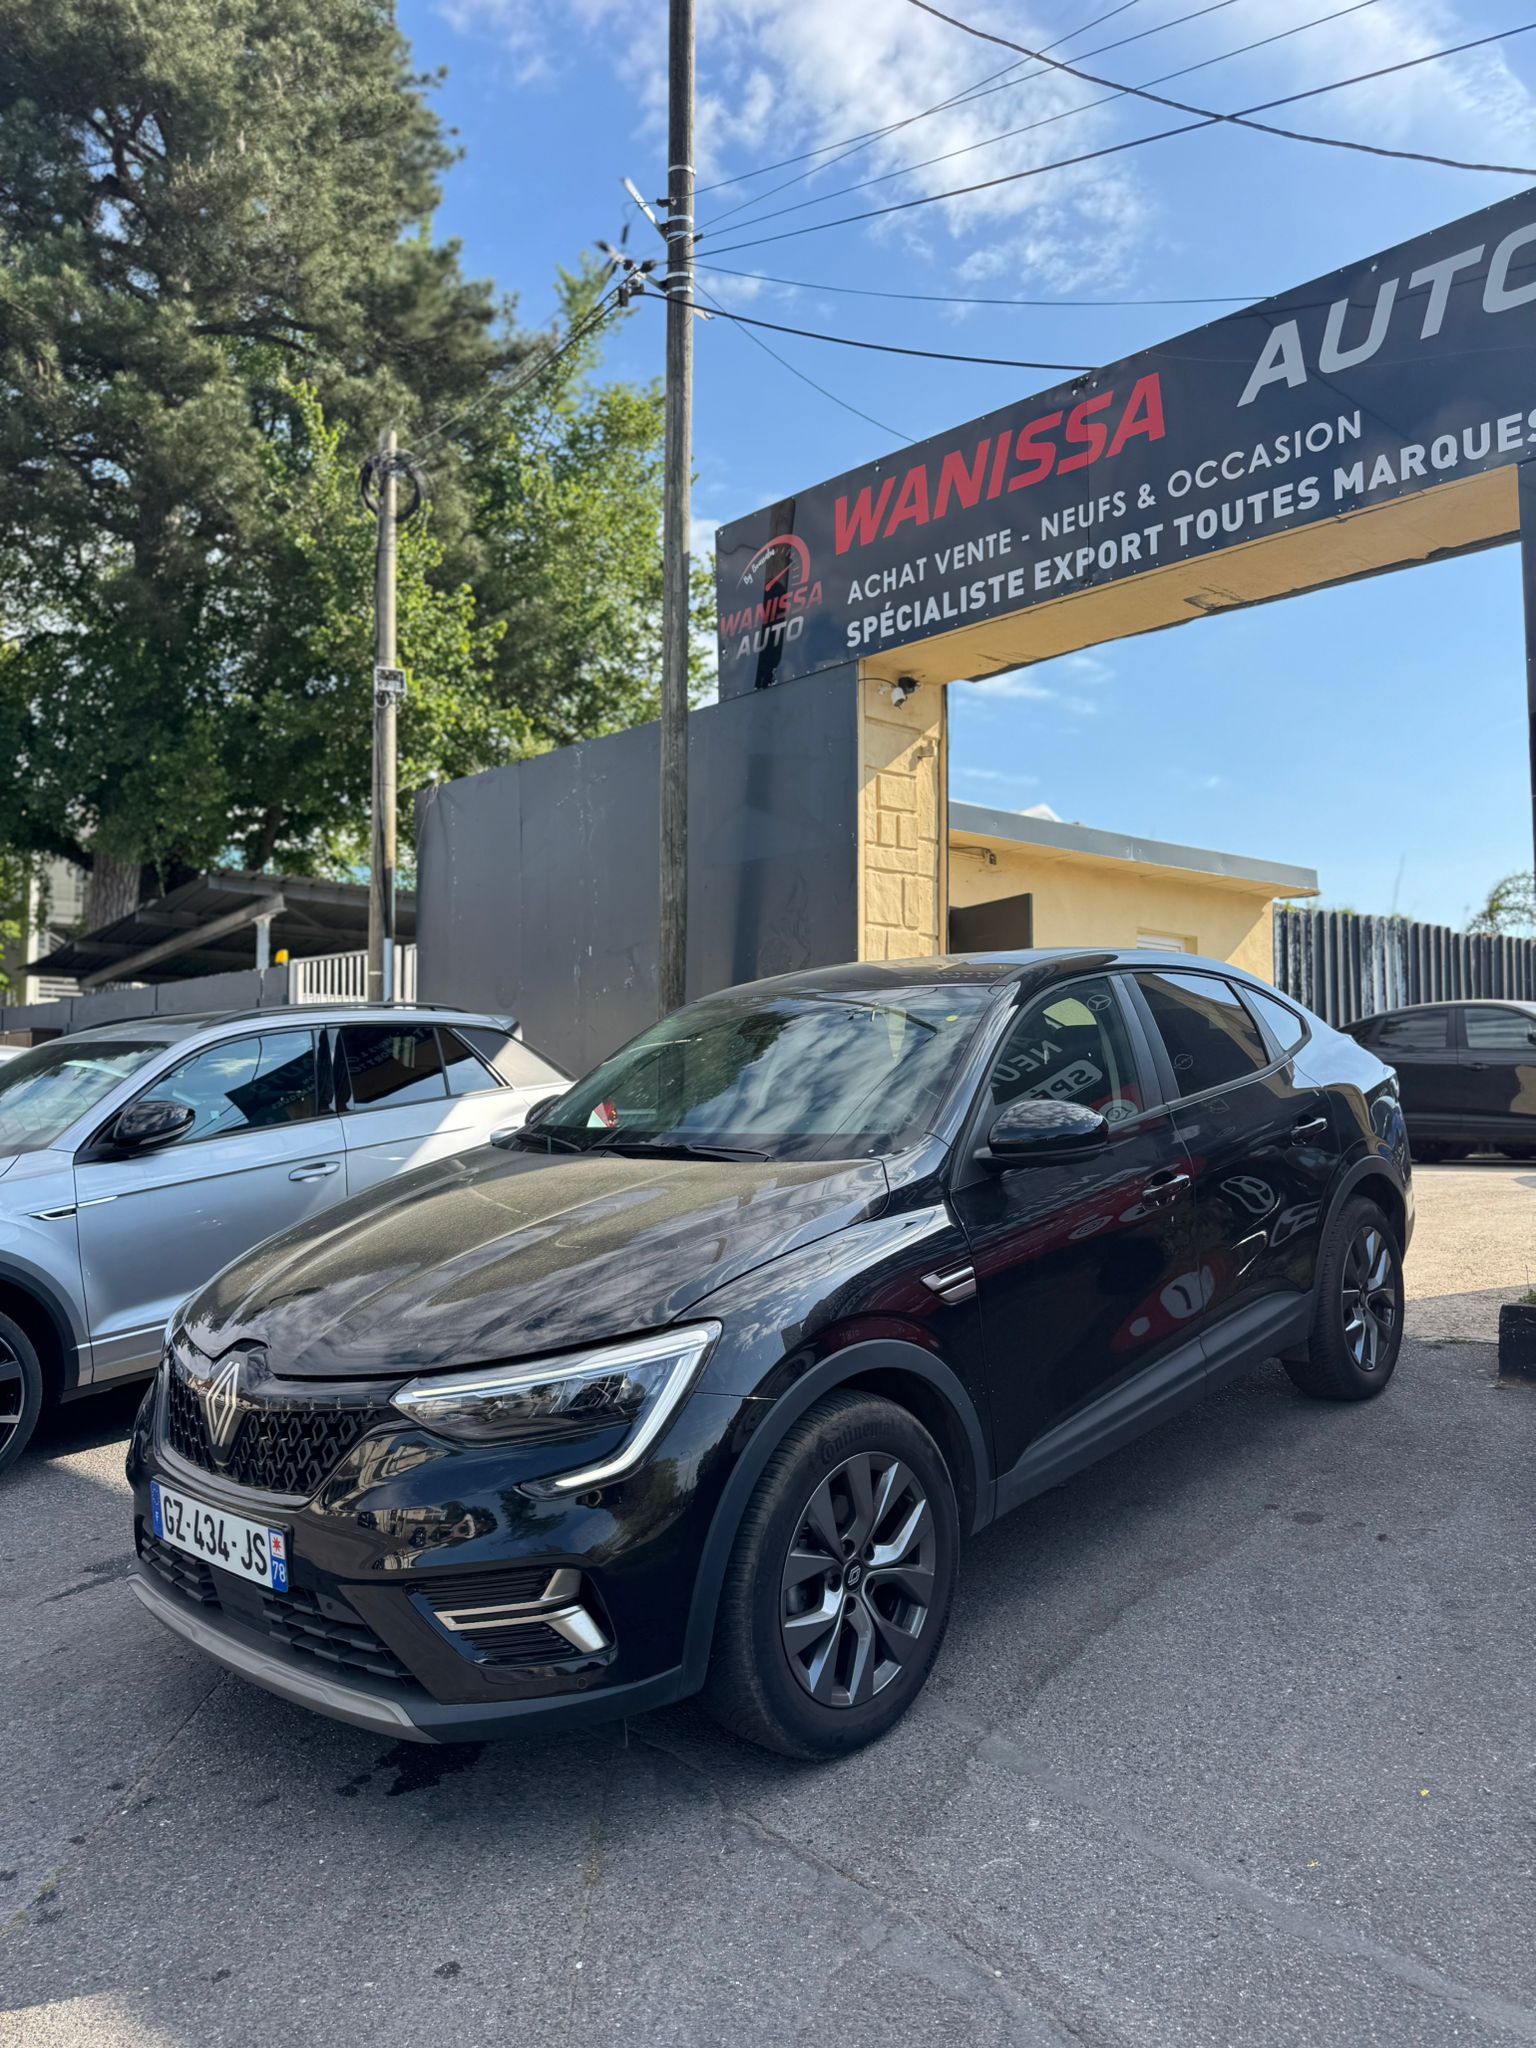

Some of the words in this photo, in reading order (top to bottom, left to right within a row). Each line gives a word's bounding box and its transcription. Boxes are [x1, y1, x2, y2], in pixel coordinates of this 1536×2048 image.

[834, 372, 1166, 556] WANISSA
[1236, 222, 1536, 408] AUTO
[847, 556, 927, 605] ACHAT
[935, 529, 1012, 575] VENTE
[1041, 490, 1126, 541] NEUFS
[1137, 483, 1156, 509] &
[1167, 410, 1361, 498] OCCASION
[846, 567, 1025, 648] SPÉCIALISTE
[1034, 523, 1164, 591] EXPORT
[1173, 476, 1321, 546] TOUTES
[720, 580, 823, 640] WANISSA
[736, 615, 804, 660] AUTO
[163, 1495, 268, 1576] GZ-434-JS
[272, 1560, 286, 1583] 78
